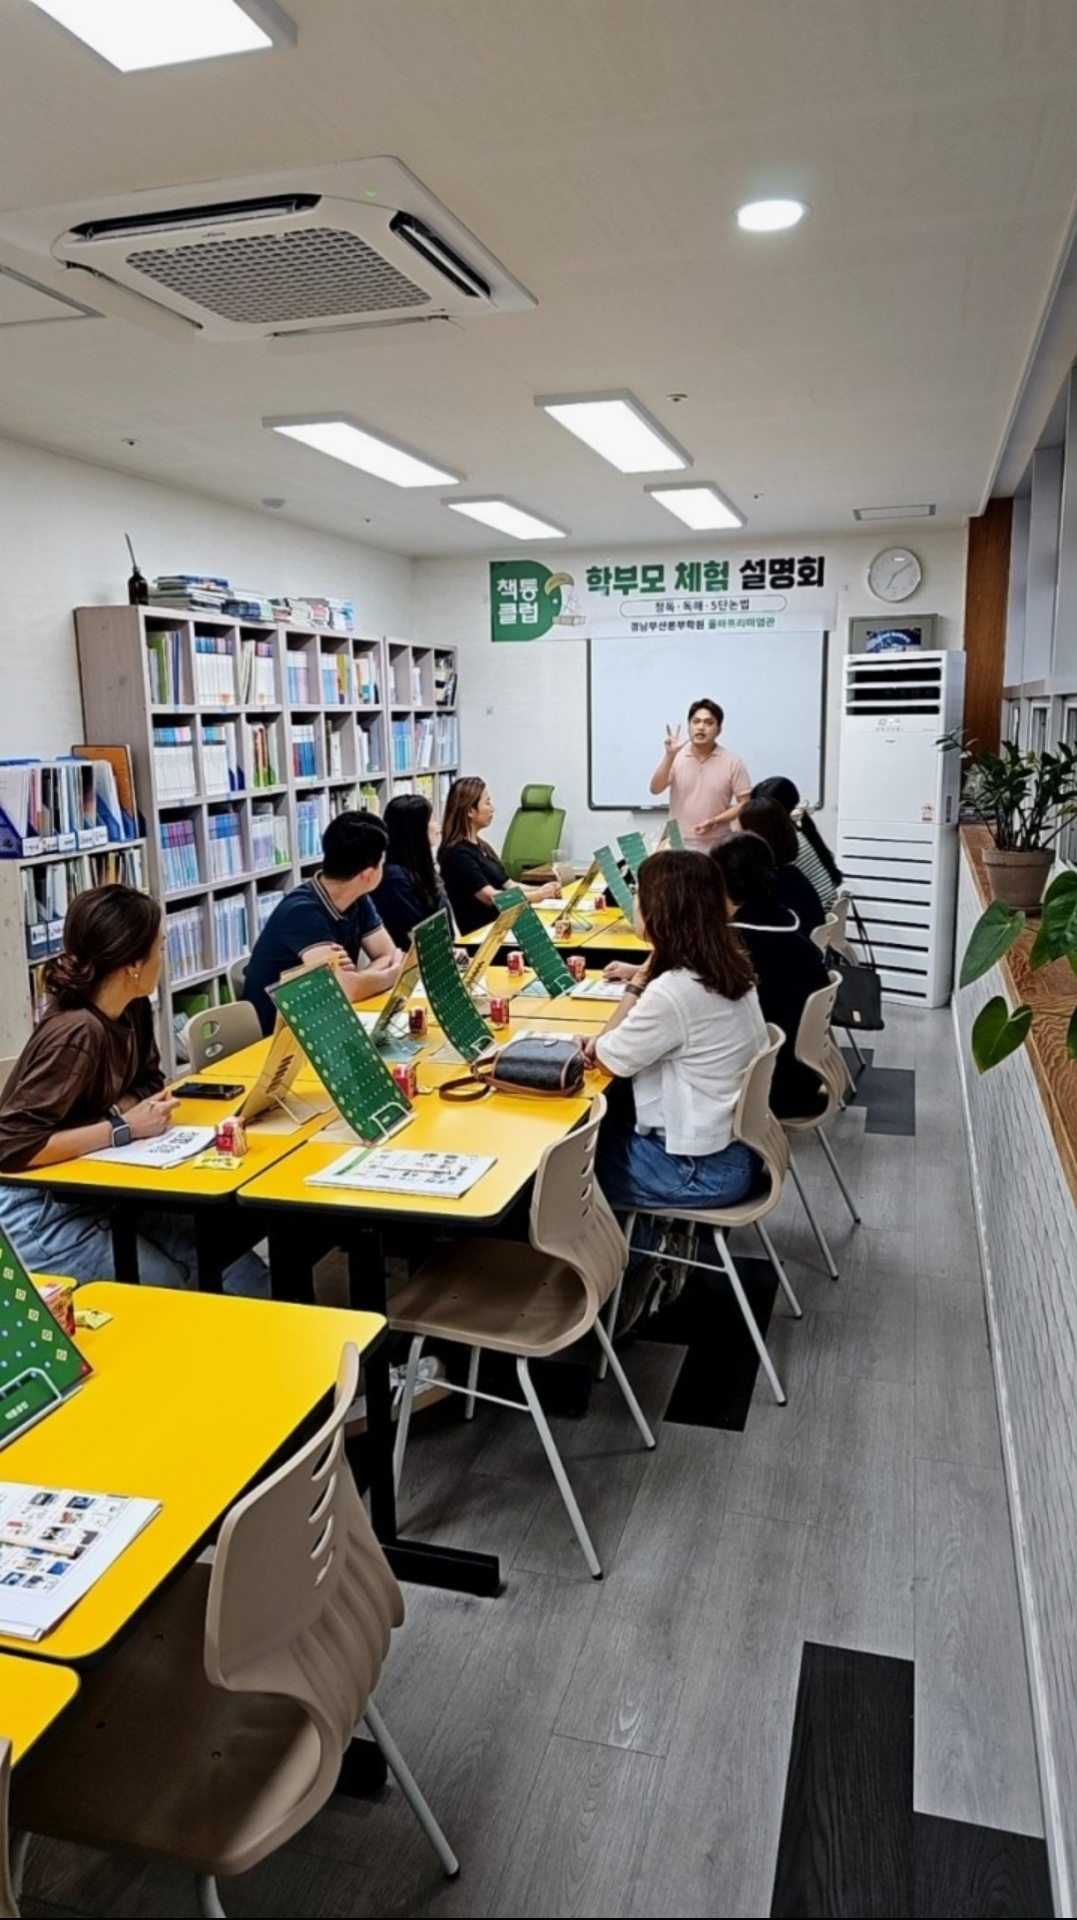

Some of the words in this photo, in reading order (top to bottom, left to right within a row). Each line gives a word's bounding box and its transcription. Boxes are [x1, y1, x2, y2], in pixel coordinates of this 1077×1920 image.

[586, 564, 665, 596] 학부모
[674, 561, 729, 592] 체험
[739, 556, 825, 590] 설명회
[497, 578, 538, 602] 책통
[498, 602, 538, 625] 클럽
